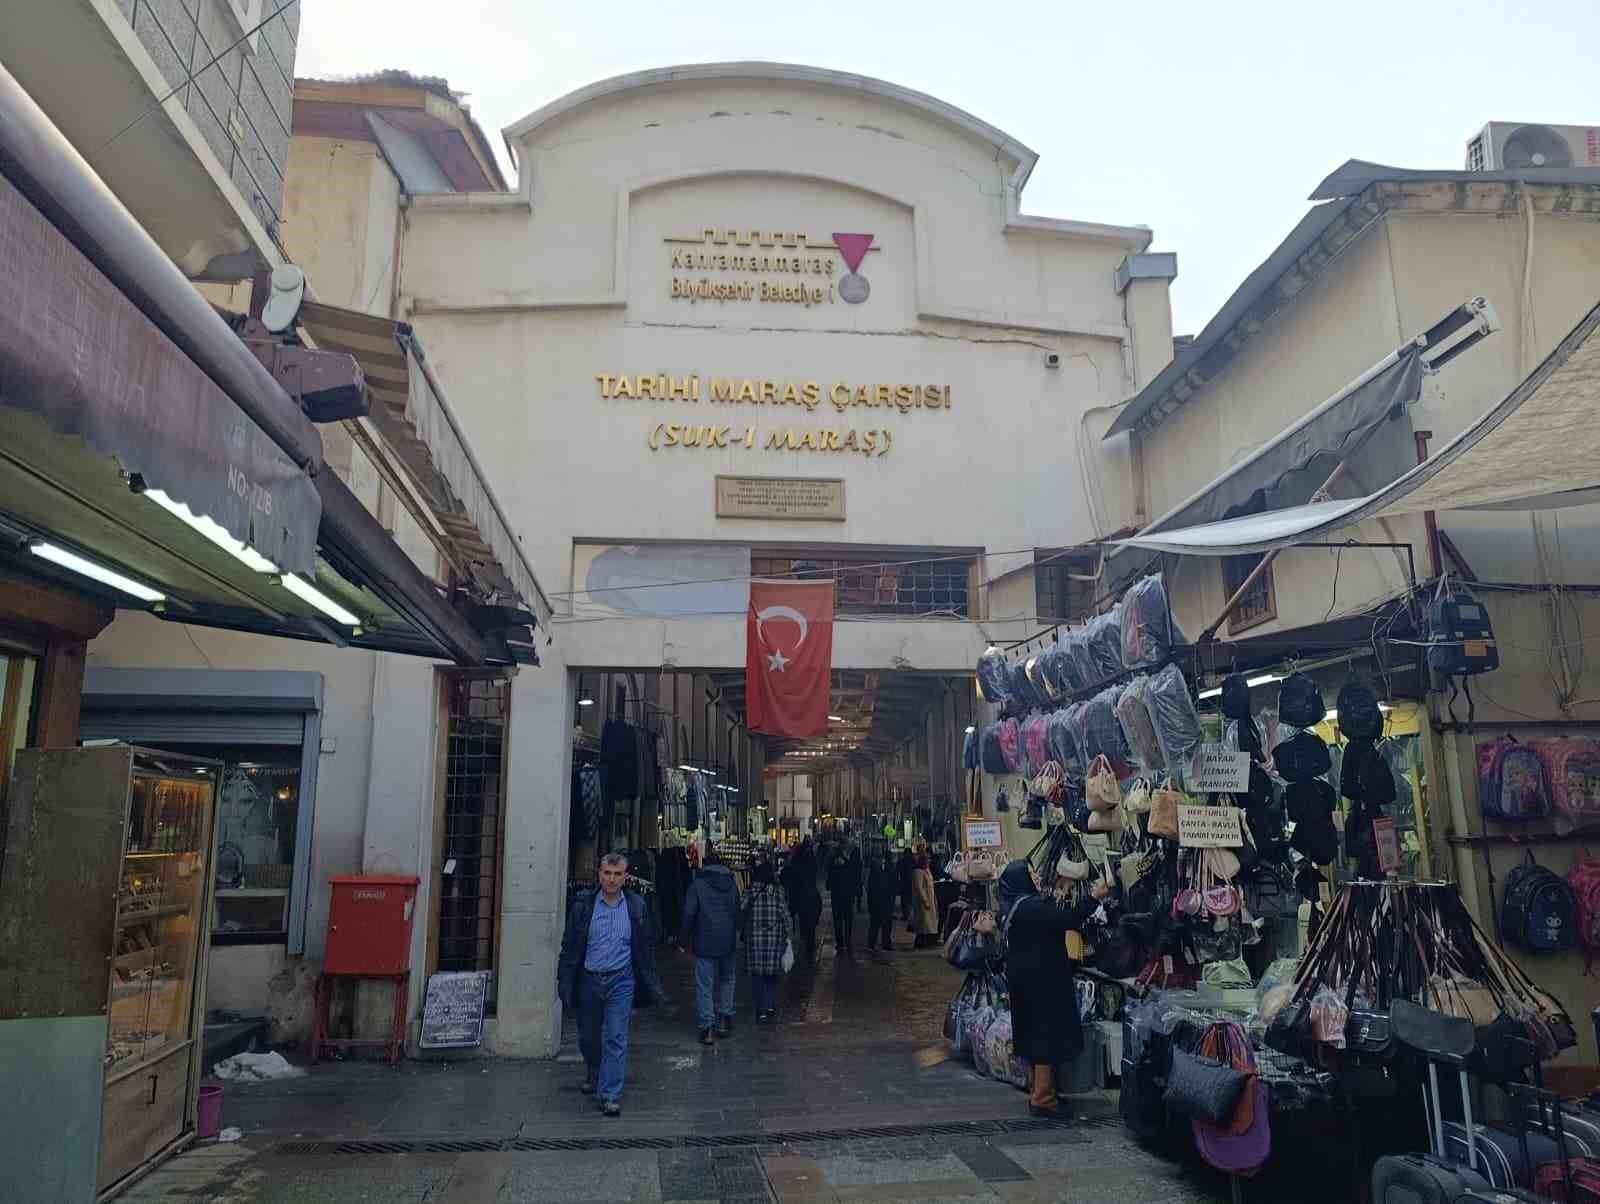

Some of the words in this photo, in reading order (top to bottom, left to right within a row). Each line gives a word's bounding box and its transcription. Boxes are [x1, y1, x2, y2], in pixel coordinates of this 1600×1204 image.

[671, 248, 835, 279] Kahramanmaraş
[671, 278, 754, 305] Büyükşehir
[596, 373, 699, 402] TARİHİ
[709, 378, 820, 411] MARAŞ
[830, 381, 952, 414] ÇARŞISI
[763, 427, 892, 457] MARAŞ)
